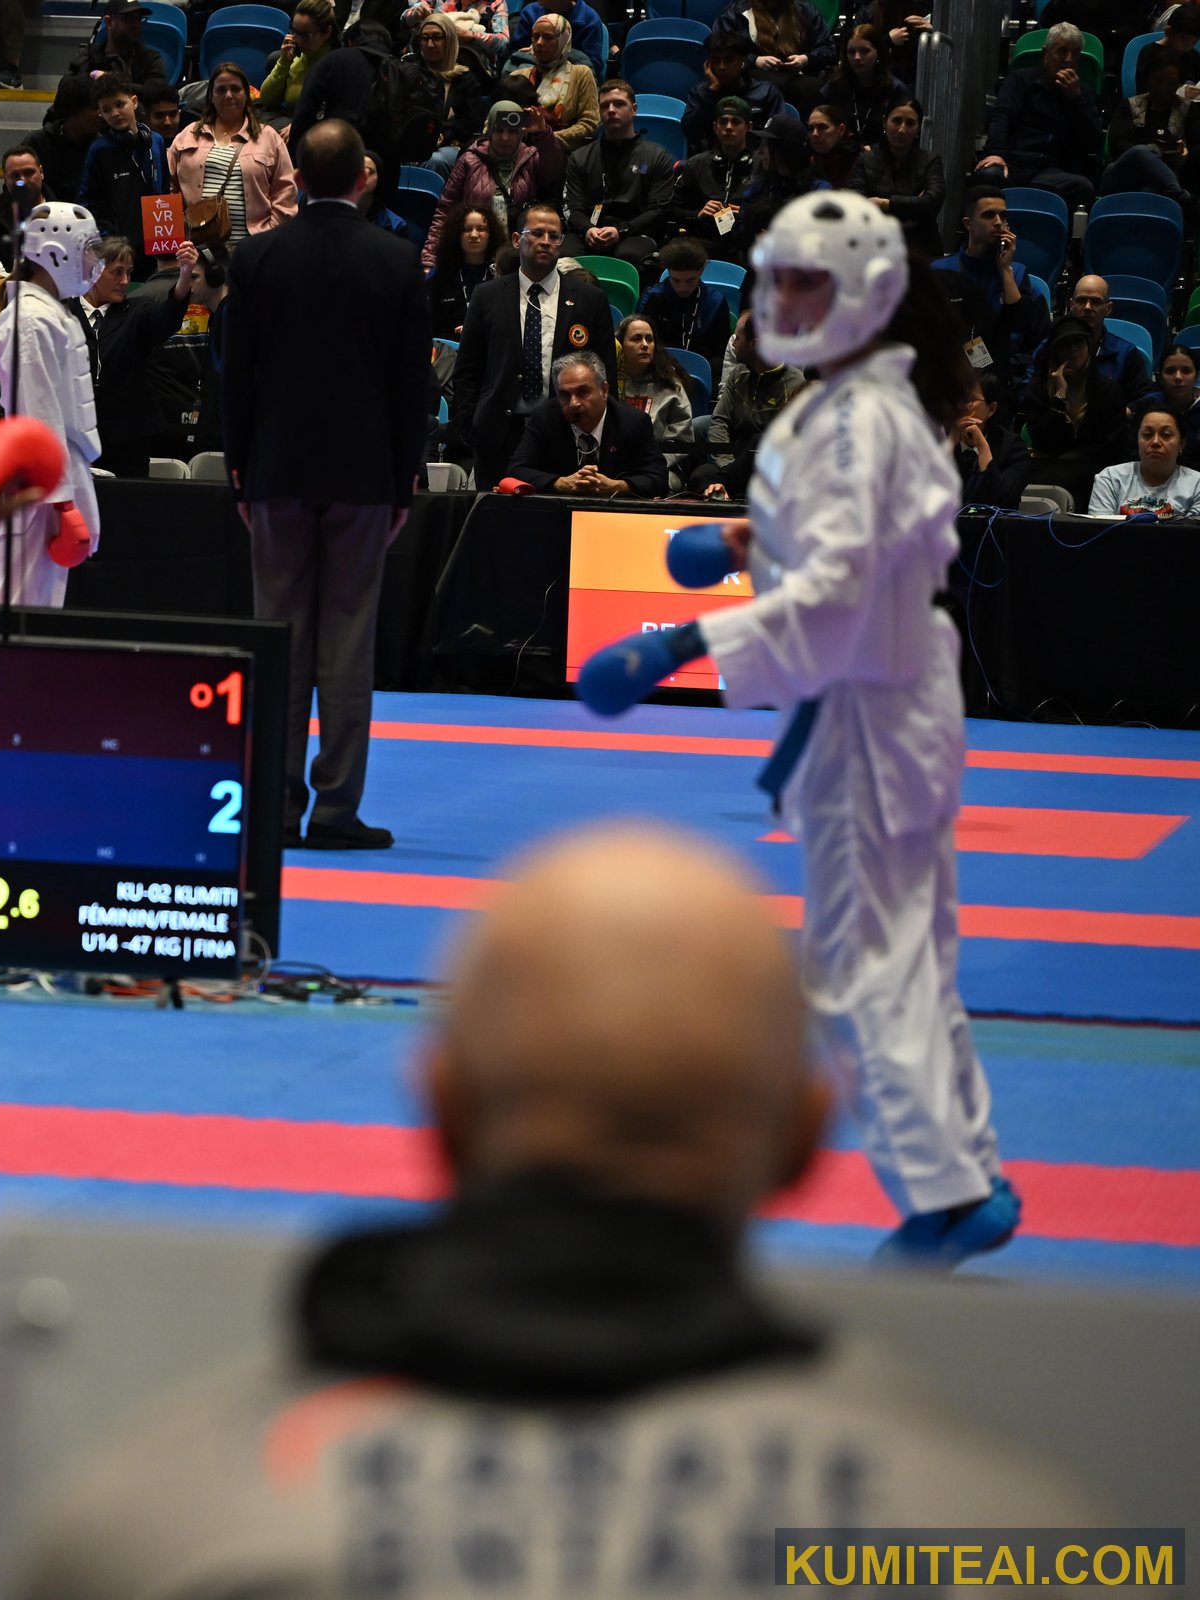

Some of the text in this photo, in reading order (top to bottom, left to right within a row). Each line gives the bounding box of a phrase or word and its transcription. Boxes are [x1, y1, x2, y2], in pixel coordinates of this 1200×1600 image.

[152, 210, 173, 222] VR
[154, 224, 174, 237] RV
[152, 240, 180, 252] AKA
[207, 780, 243, 834] 2
[117, 881, 172, 904] KU-02
[81, 932, 119, 953] U14
[120, 935, 152, 955] -47
[154, 936, 182, 957] KG
